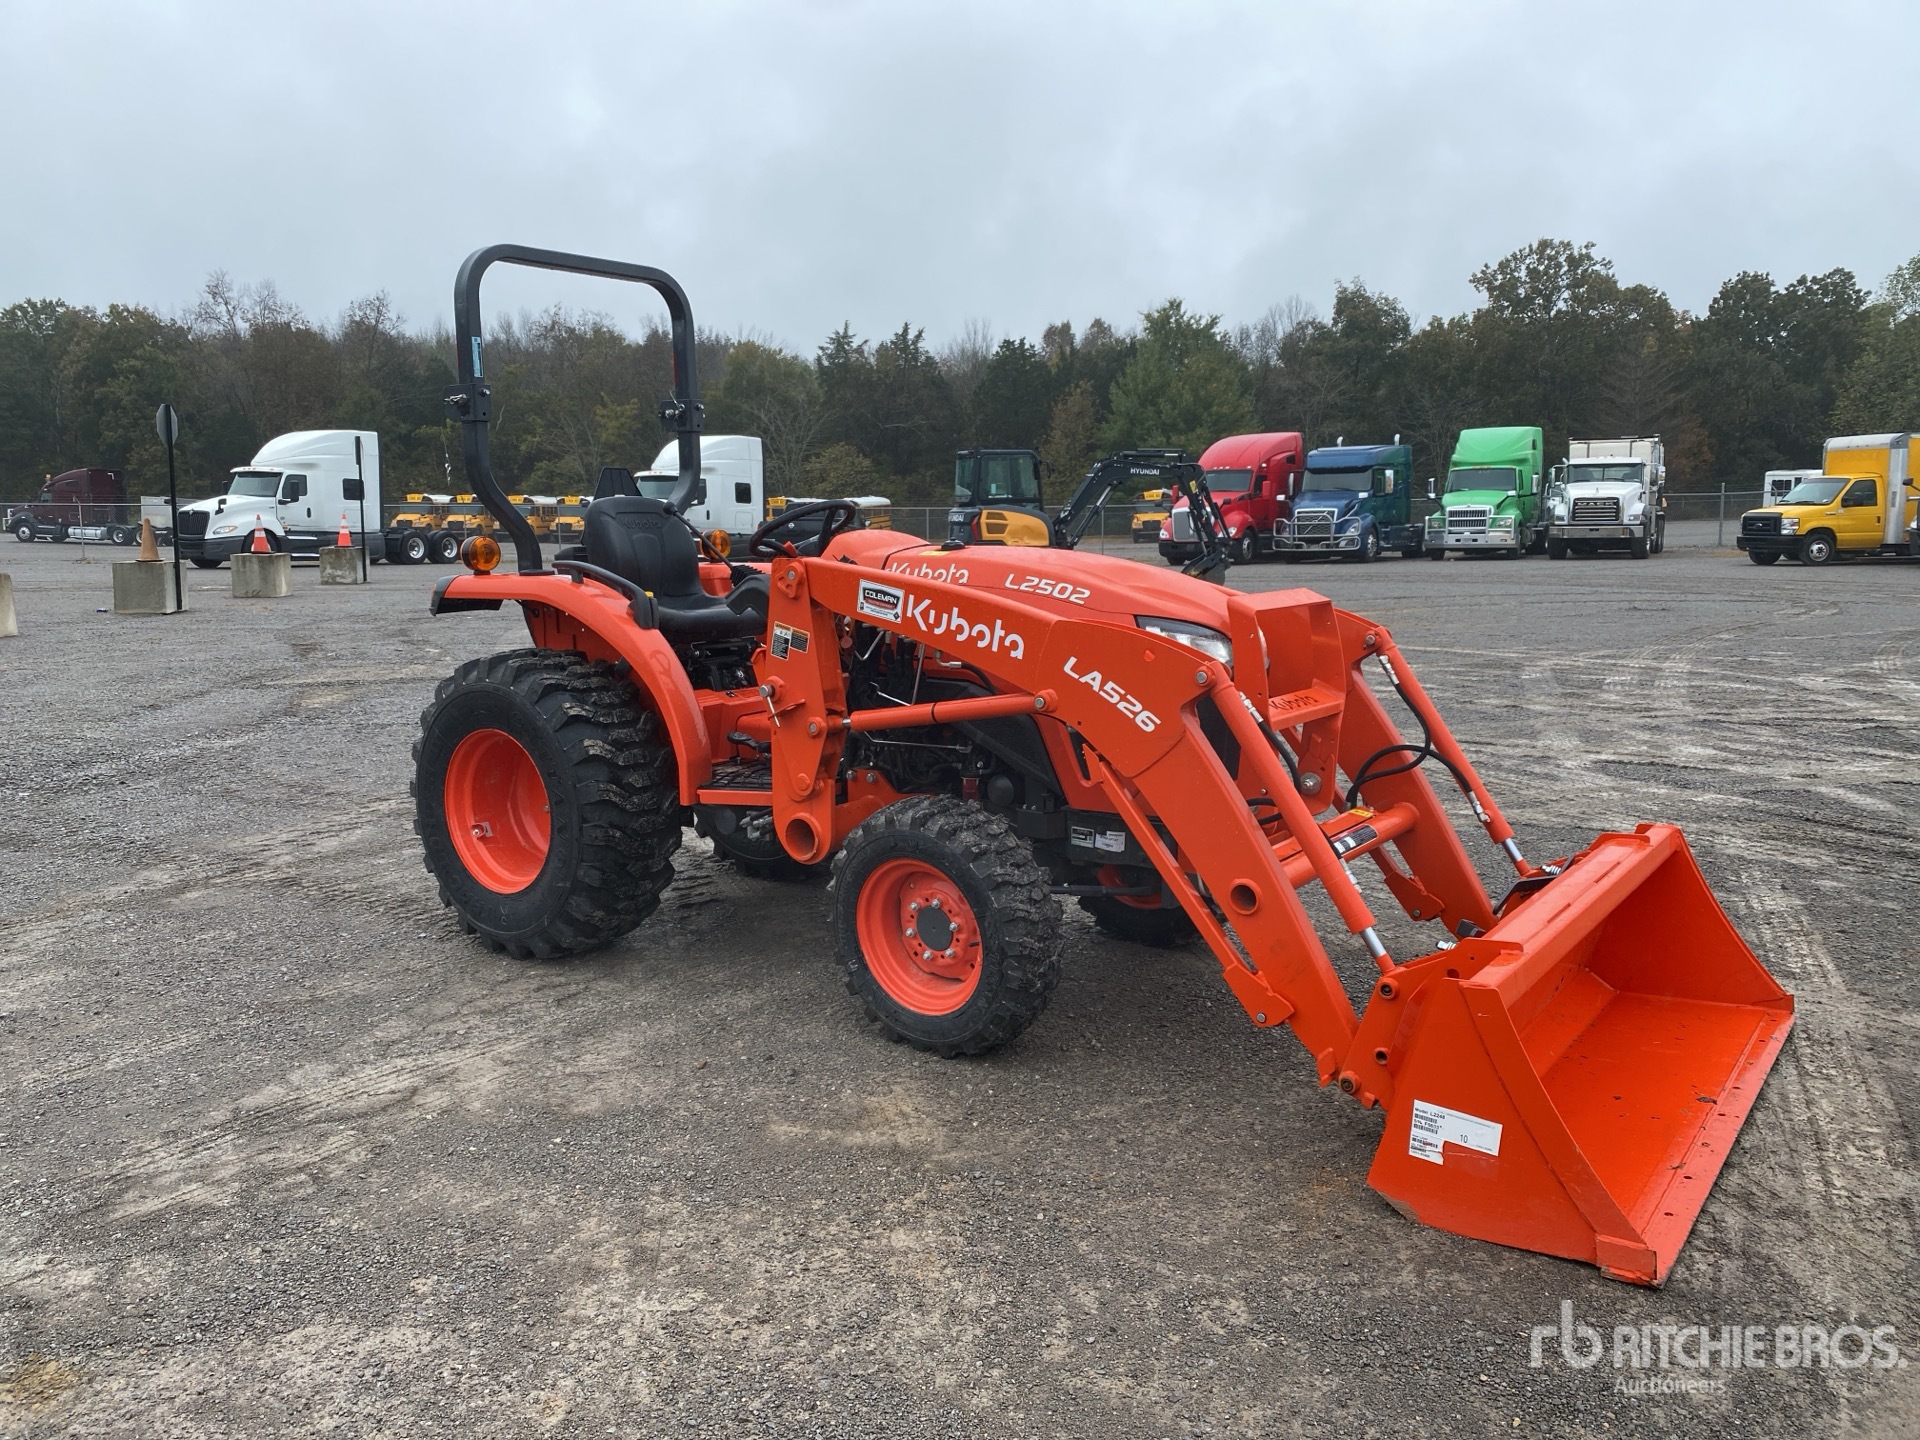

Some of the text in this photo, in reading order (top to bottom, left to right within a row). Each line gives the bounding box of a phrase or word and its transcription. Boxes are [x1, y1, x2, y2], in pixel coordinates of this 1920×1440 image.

[1130, 467, 1160, 476] HYUNDAI
[620, 516, 662, 530] Kubota
[890, 562, 970, 585] Kubota
[865, 590, 898, 605] COLEMAN
[1005, 573, 1091, 605] L2502
[906, 594, 1025, 660] Kubota
[1063, 656, 1161, 732] LA526
[1459, 1133, 1469, 1144] 10
